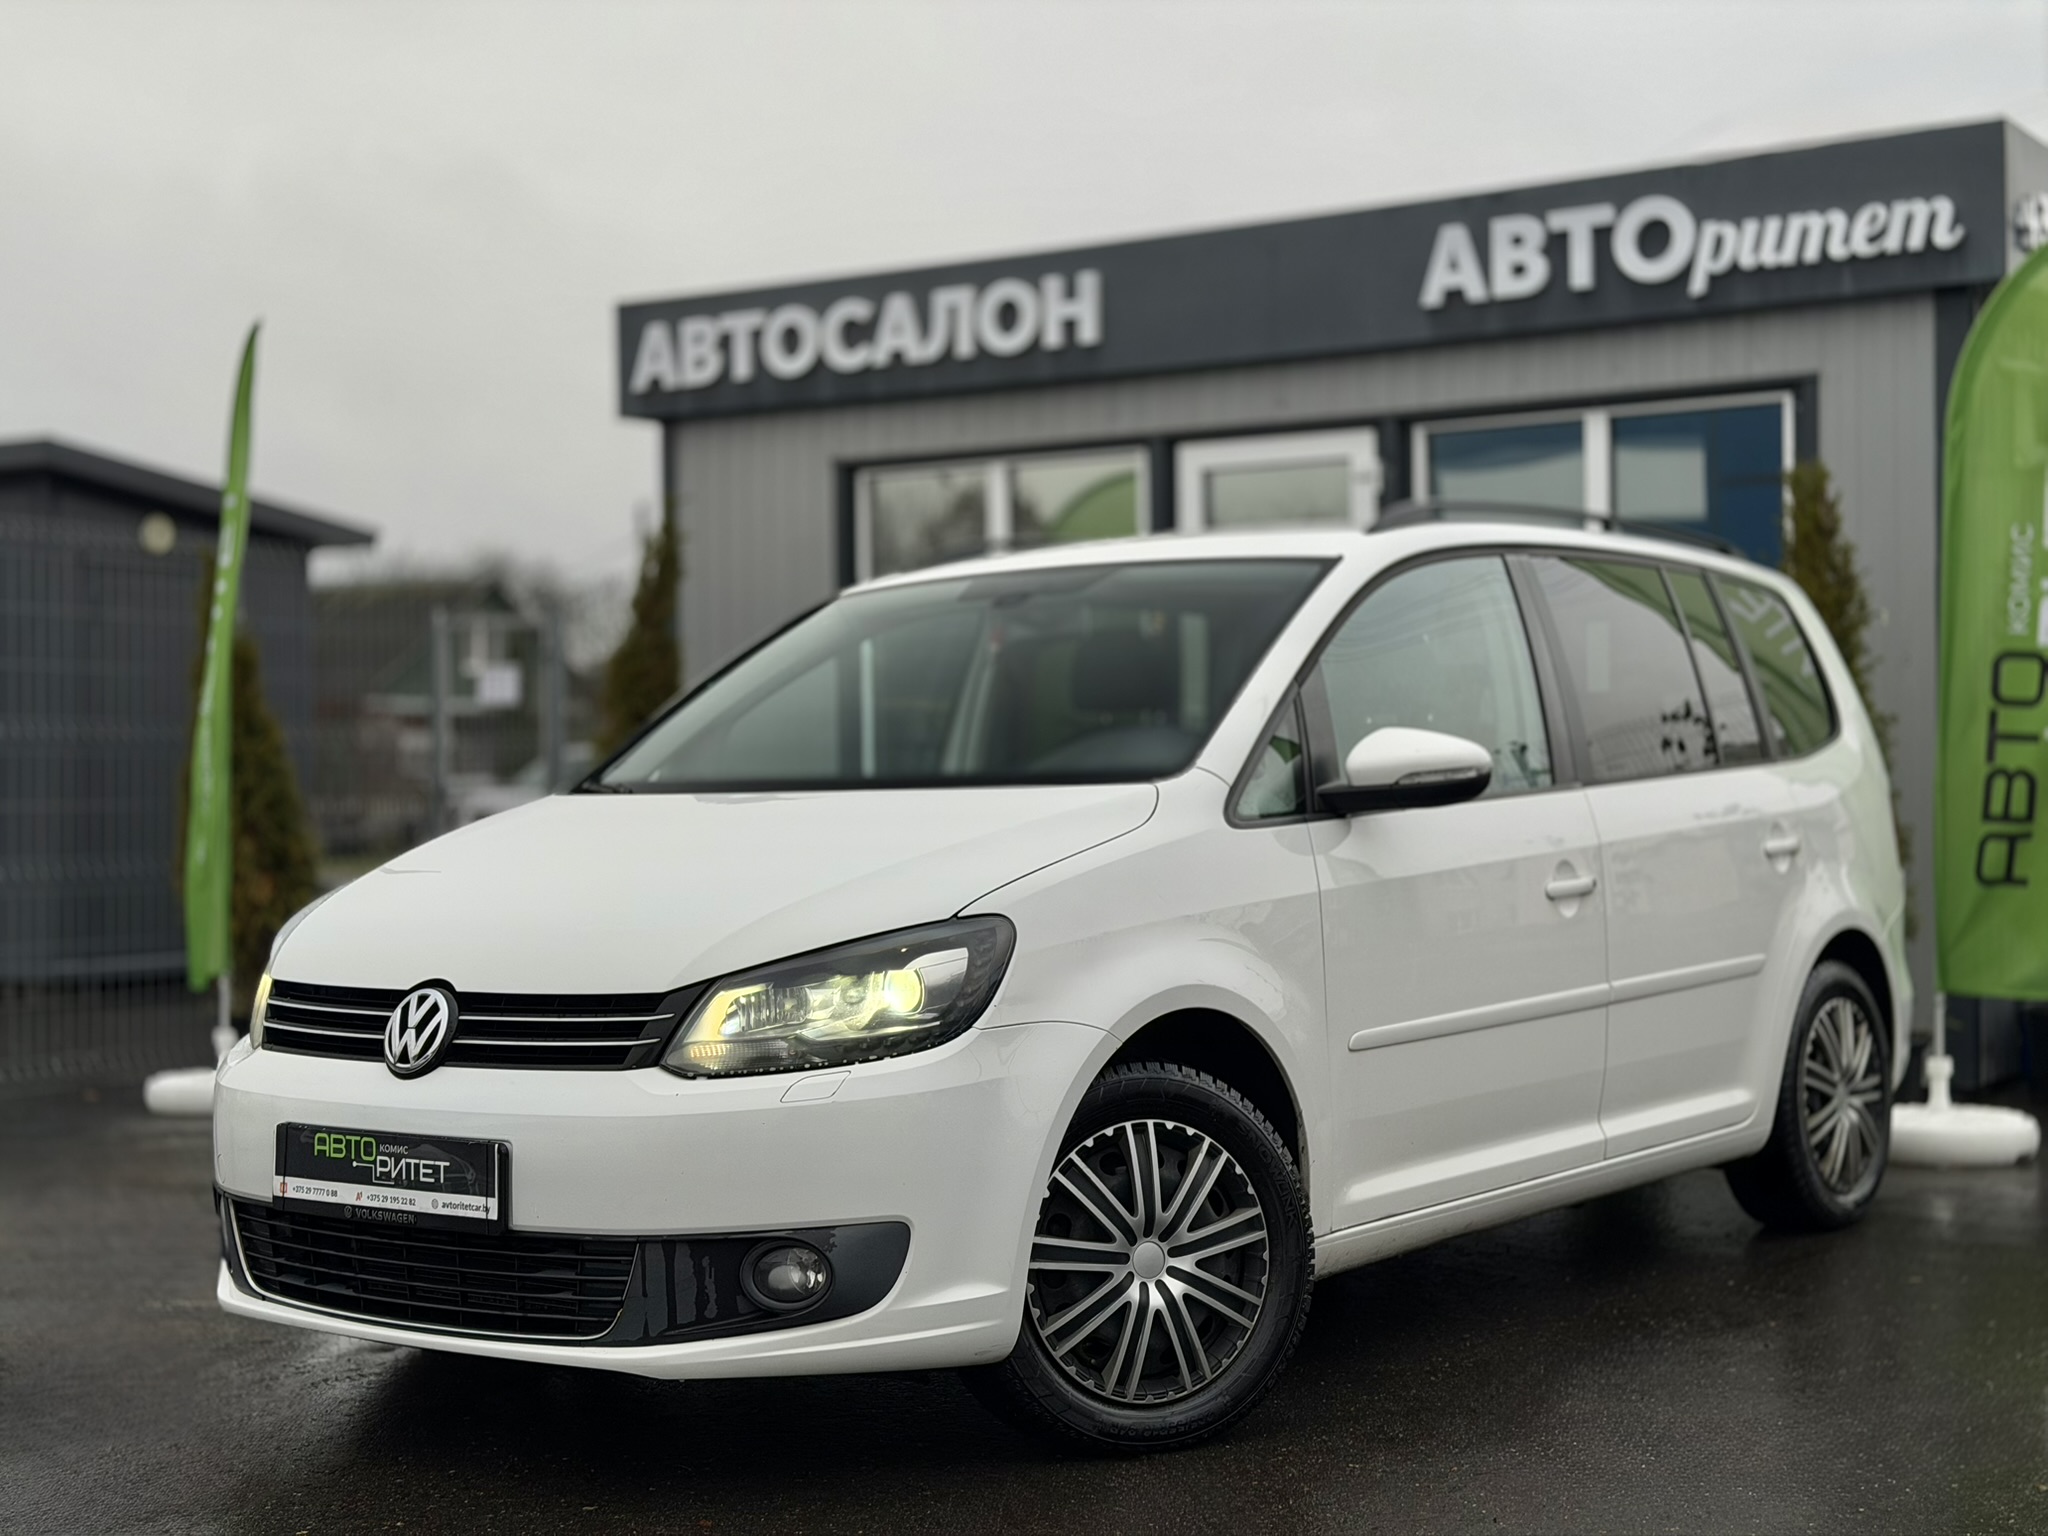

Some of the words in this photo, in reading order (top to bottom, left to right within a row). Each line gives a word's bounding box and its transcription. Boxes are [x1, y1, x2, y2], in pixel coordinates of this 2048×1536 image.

[1418, 193, 1966, 310] АВТОритет
[628, 268, 1103, 394] АВТОСАЛОН
[2007, 521, 2035, 636] КОМИС
[1975, 651, 2047, 888] АВТО
[314, 1133, 376, 1161] АВТО
[379, 1143, 409, 1155] КОМИС
[376, 1155, 450, 1184] РИТЕТ
[292, 1185, 305, 1194] +375
[305, 1186, 312, 1195] 29
[312, 1187, 326, 1196] 7777
[330, 1189, 338, 1198] 88
[366, 1193, 381, 1202] +375
[381, 1195, 389, 1203] 29
[389, 1196, 400, 1205] 195
[400, 1197, 409, 1206] 22
[408, 1198, 416, 1207] 82
[356, 1207, 415, 1224] VOLKSWAGEN
[441, 1201, 491, 1214] avtoritetcar.by
